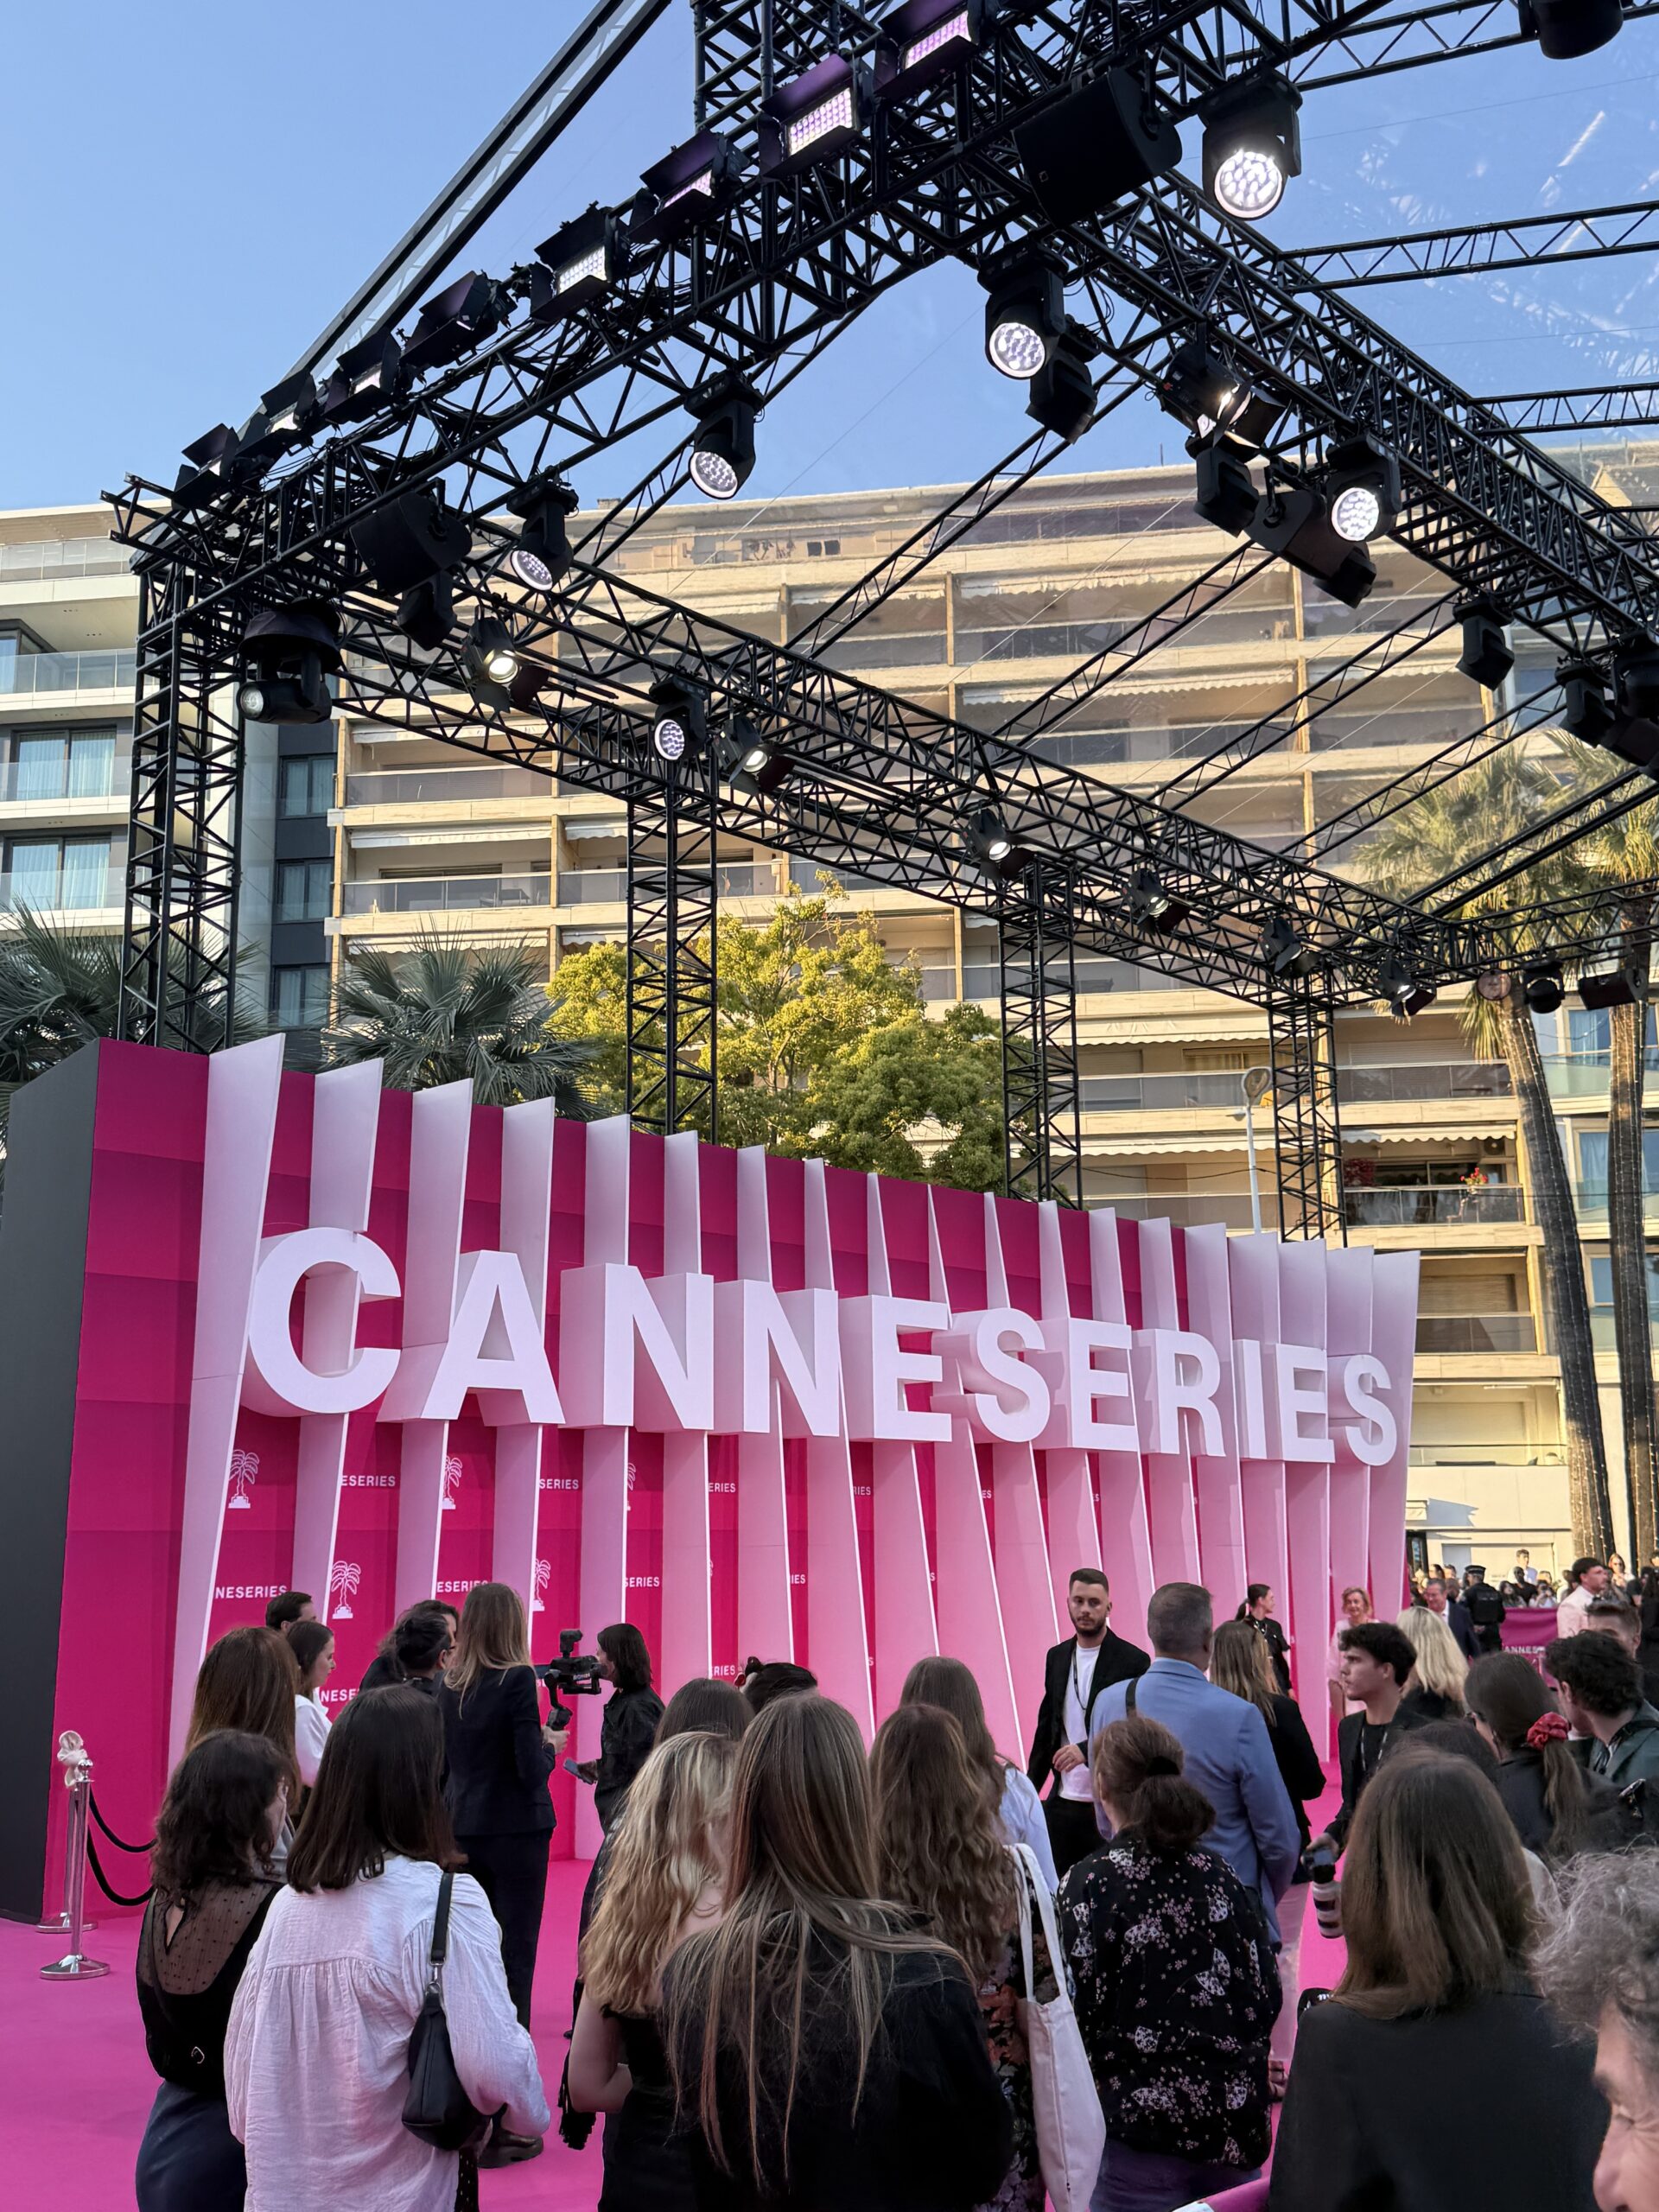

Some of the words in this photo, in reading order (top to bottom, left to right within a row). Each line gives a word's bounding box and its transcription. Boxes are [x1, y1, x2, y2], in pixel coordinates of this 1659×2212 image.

[248, 1227, 1398, 1466] CANNESERIES
[539, 1478, 579, 1490] SERIES
[215, 1585, 288, 1599] NESERIES
